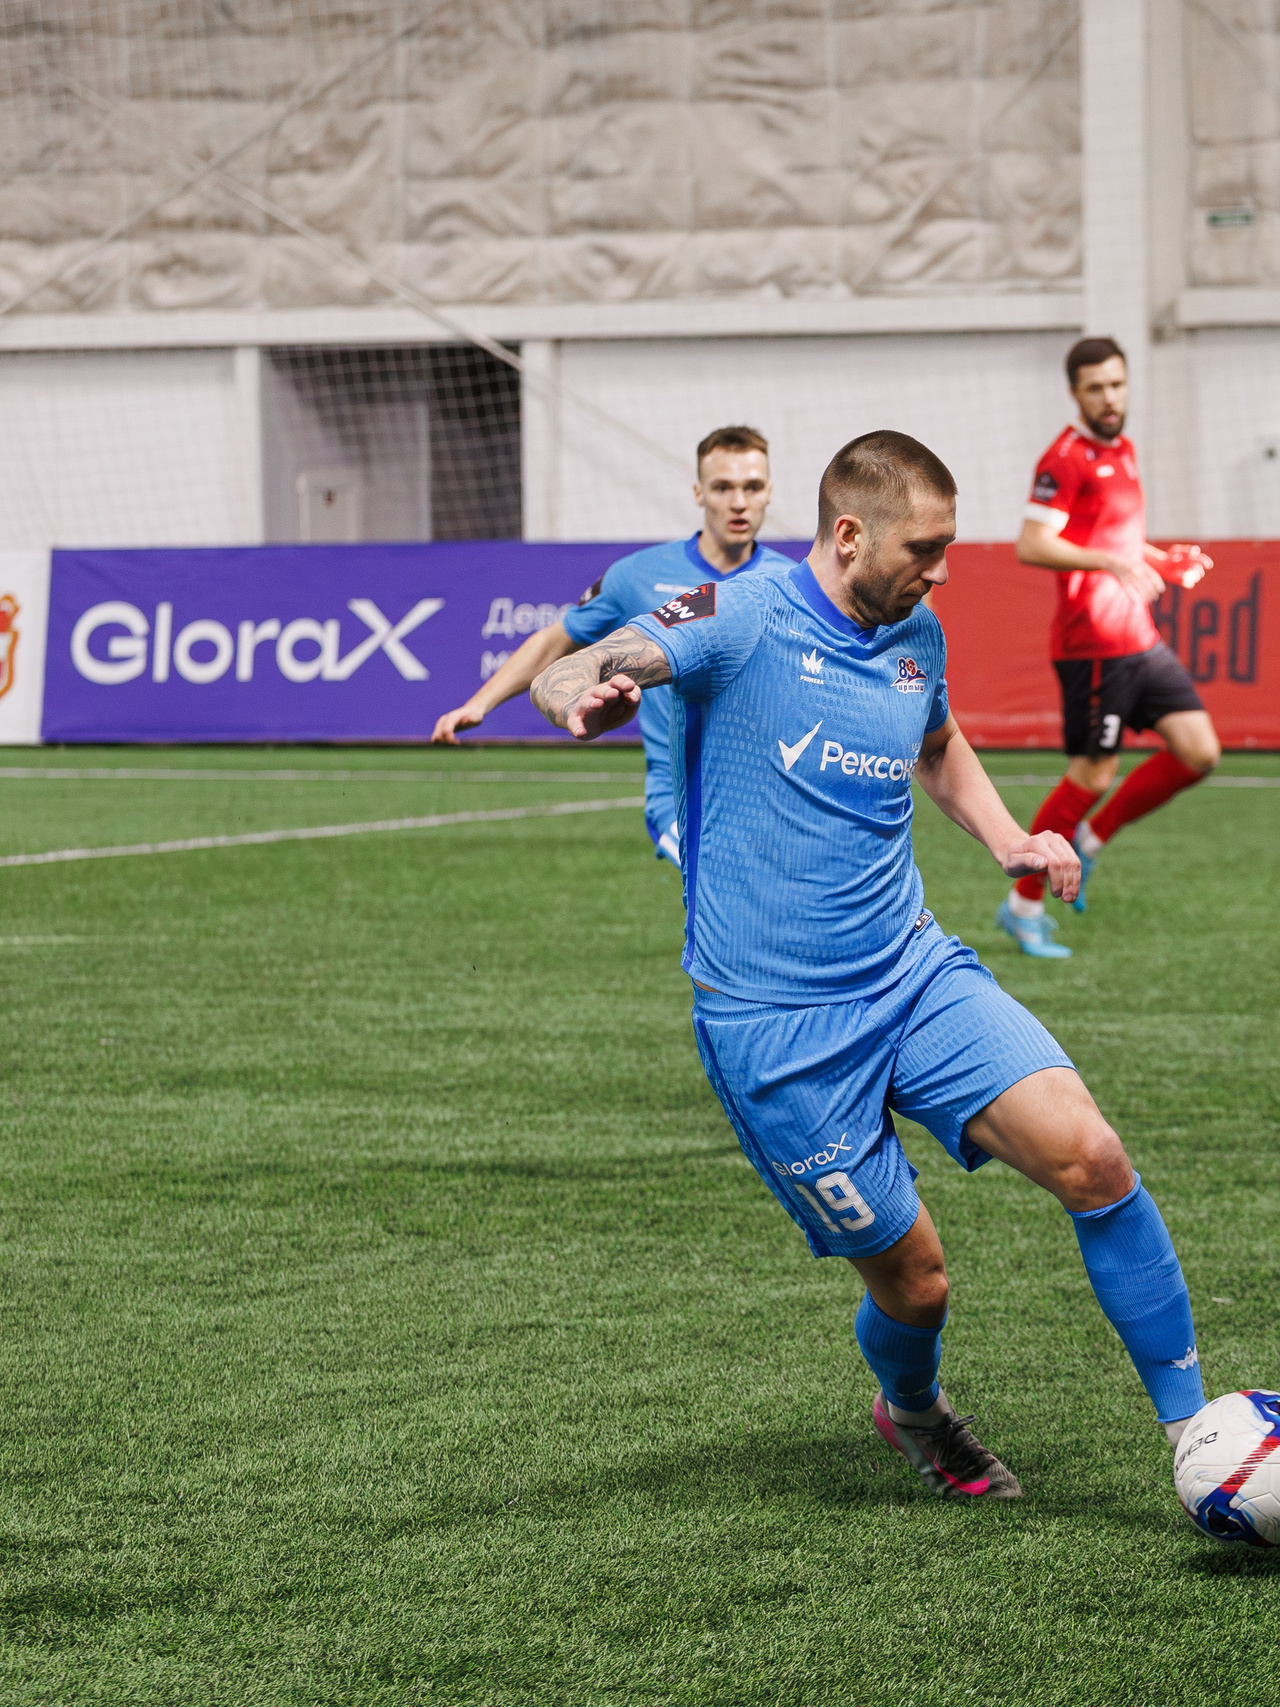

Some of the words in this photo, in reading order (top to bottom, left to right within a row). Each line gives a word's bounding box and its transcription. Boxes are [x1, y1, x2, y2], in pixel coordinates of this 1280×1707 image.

[71, 597, 446, 686] GloraX
[1099, 713, 1122, 749] 3
[820, 740, 918, 781] Рексон
[771, 1132, 852, 1177] GloraX
[793, 1171, 876, 1233] 19
